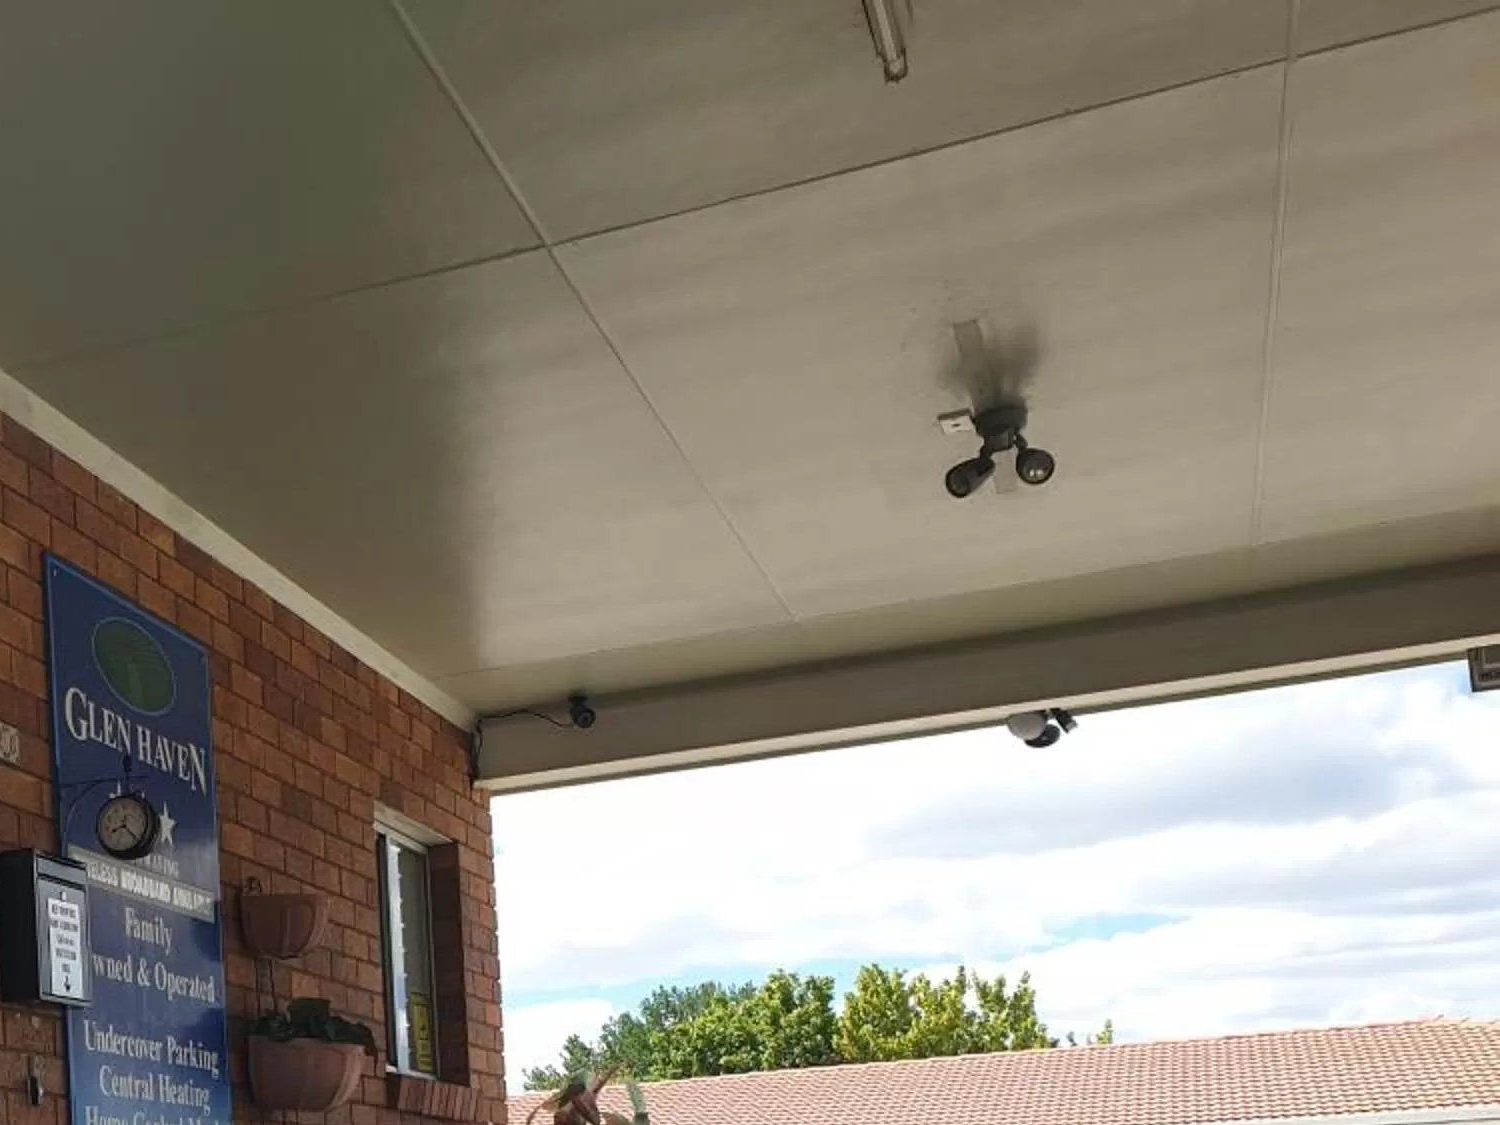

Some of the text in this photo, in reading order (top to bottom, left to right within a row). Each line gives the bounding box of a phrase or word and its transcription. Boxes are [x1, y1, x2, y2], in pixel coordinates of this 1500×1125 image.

[64, 687, 132, 755] GLEN
[135, 723, 207, 797] HAVEN
[124, 906, 173, 956] Family
[92, 953, 133, 984] wned
[137, 956, 151, 987] &
[154, 962, 215, 1003] Operated
[84, 1019, 220, 1080] Undercover Parking
[100, 1064, 211, 1117] Central Heating
